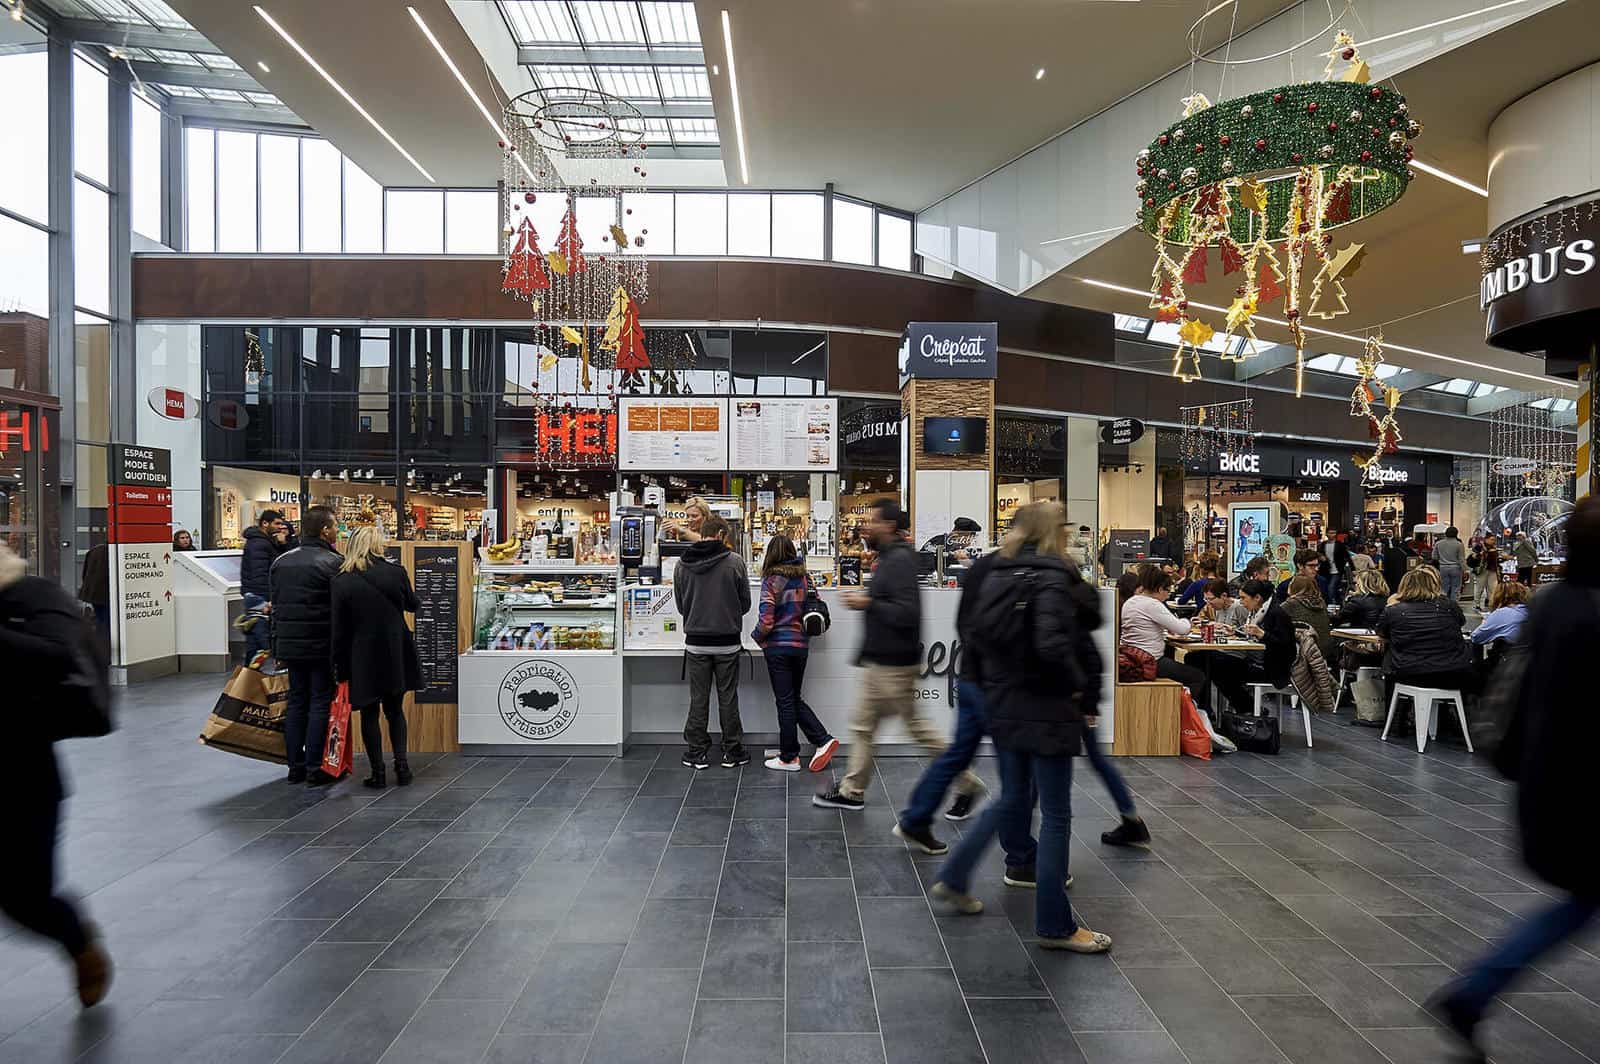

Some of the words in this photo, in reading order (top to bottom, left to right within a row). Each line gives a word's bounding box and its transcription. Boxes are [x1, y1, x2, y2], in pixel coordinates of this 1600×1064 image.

[921, 335, 986, 366] Crêp'eat
[167, 399, 184, 409] HEMA
[124, 449, 153, 460] ESPACE
[125, 460, 148, 471] MODE
[149, 462, 155, 471] &
[1220, 452, 1260, 472] BRICE
[1300, 458, 1340, 477] JULES
[124, 471, 167, 483] QUOTIDIEN
[125, 491, 149, 500] Toilettes
[1300, 492, 1320, 501] JULES
[125, 552, 151, 561] ESPACE
[125, 561, 151, 570] CINEMA
[125, 570, 164, 580] GOURMAND
[125, 592, 151, 601] ESPACE
[126, 601, 153, 610] FAMILLE
[126, 609, 163, 620] BRICOLAGE
[504, 664, 572, 701] Fabrication
[505, 709, 571, 736] Artisanale
